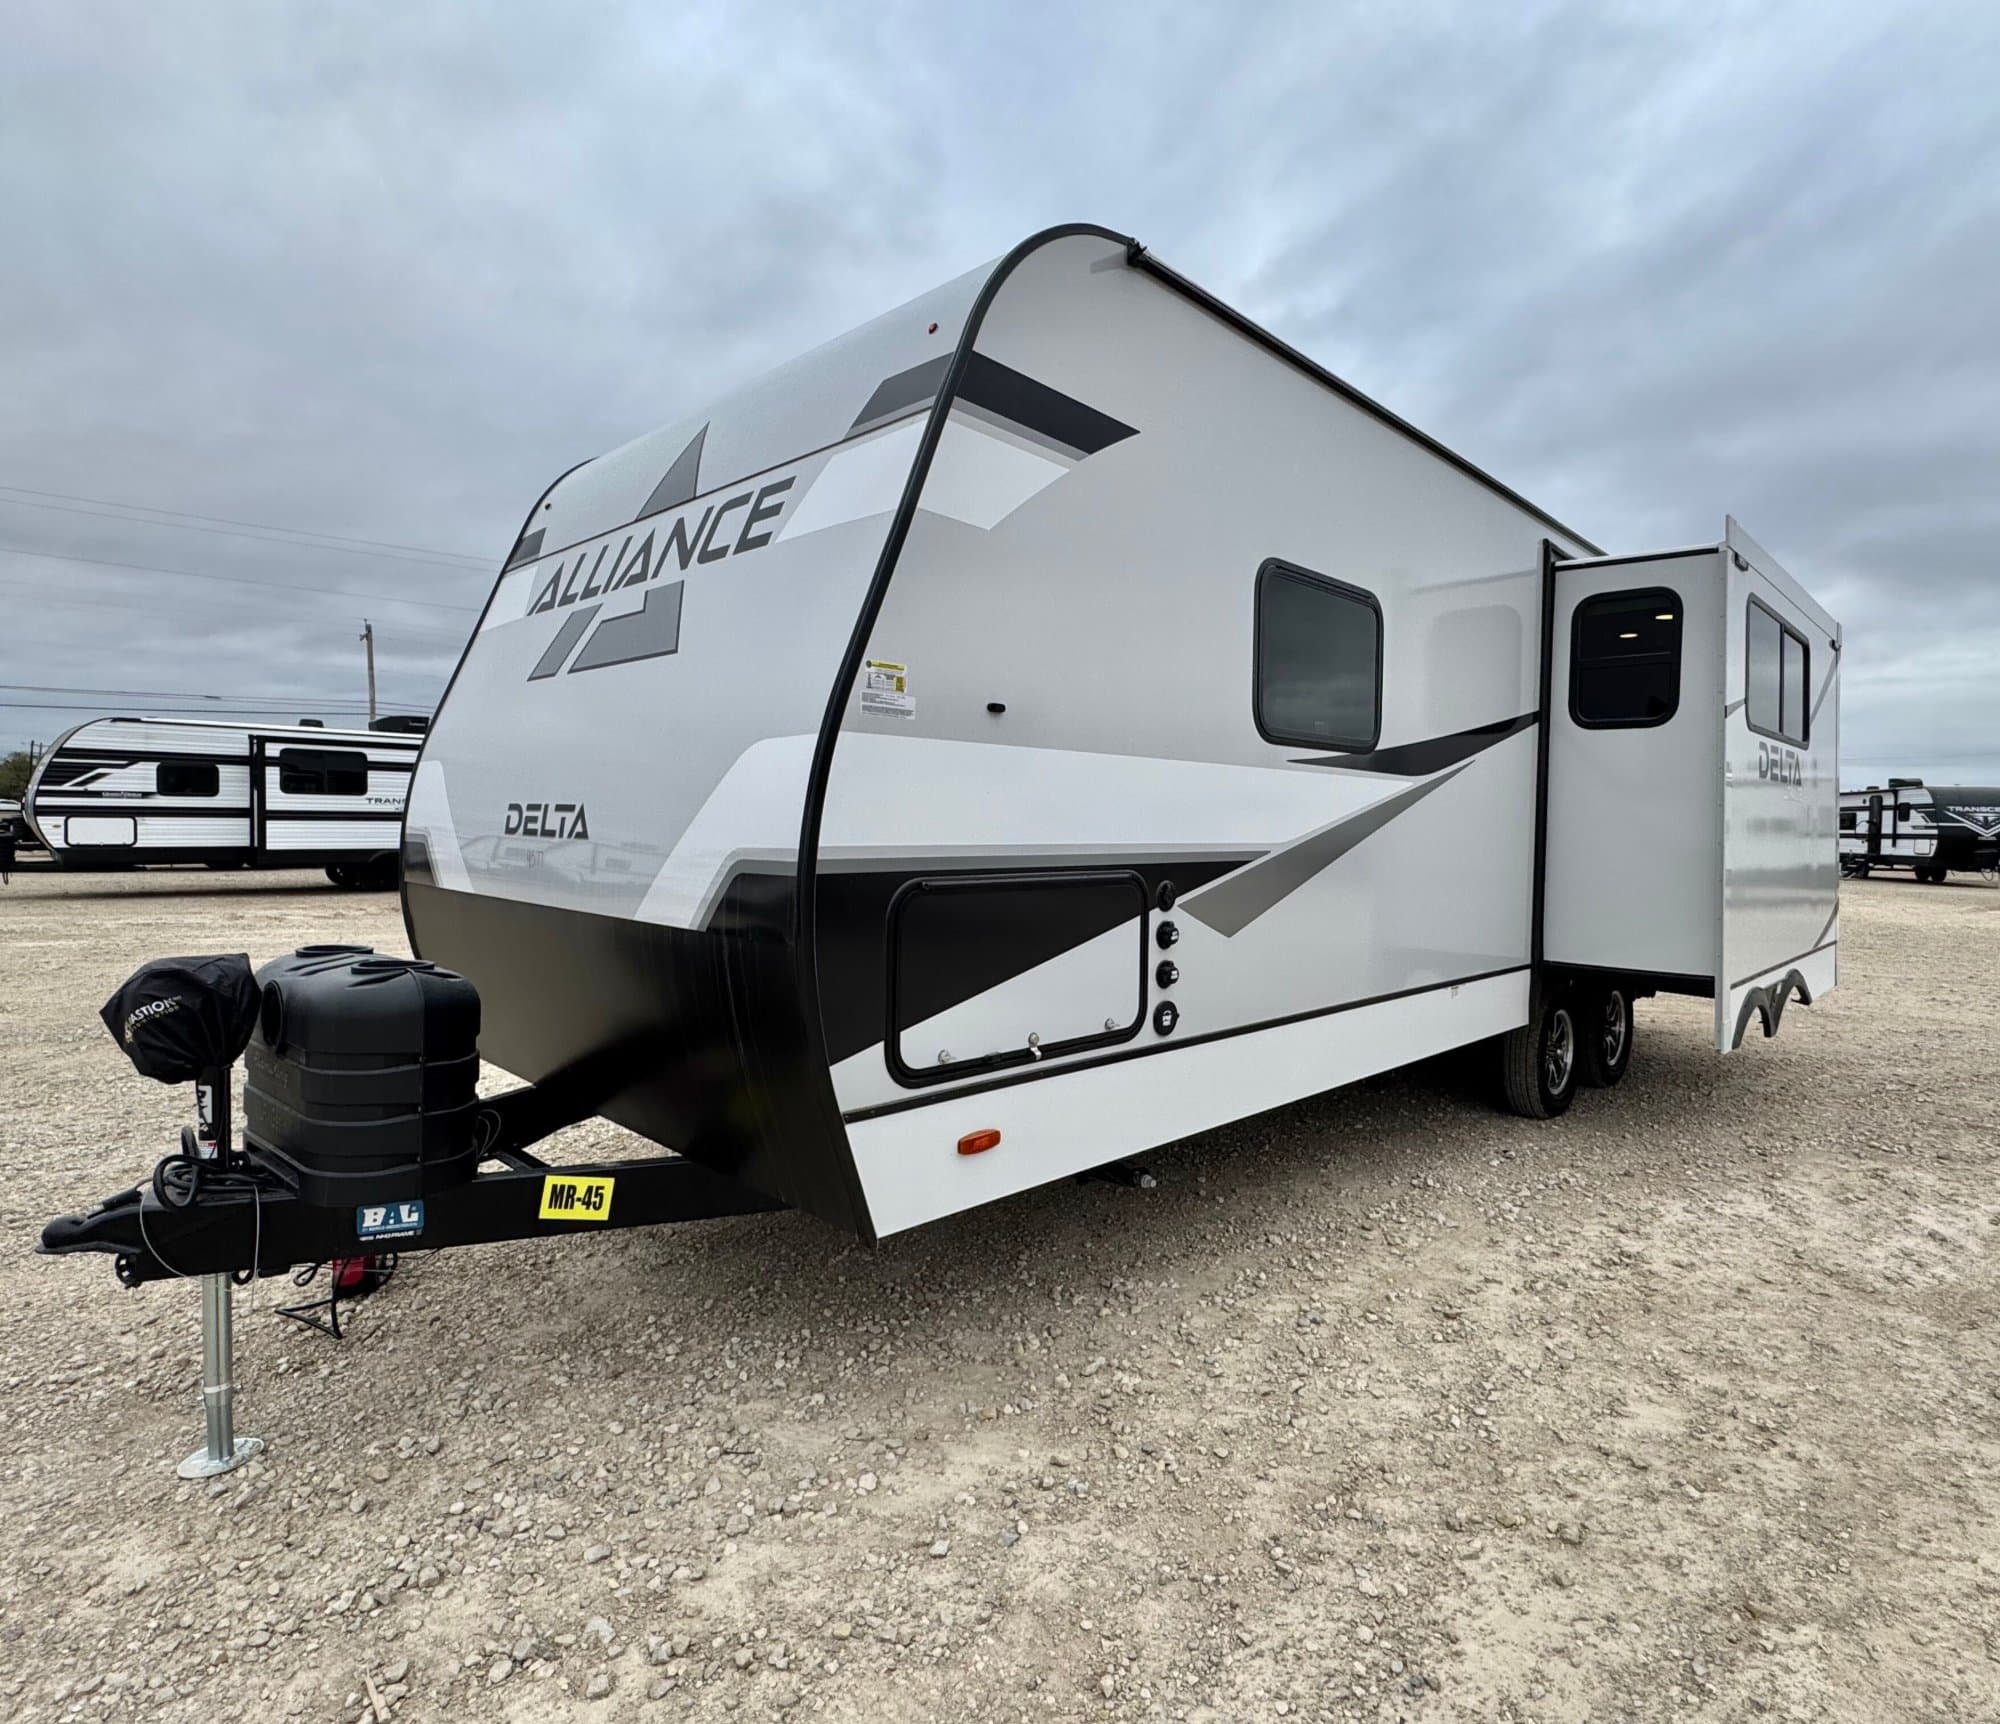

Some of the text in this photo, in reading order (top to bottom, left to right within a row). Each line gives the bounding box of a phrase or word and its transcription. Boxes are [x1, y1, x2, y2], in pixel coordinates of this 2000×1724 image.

[526, 475, 797, 617] ALLIANCE
[1758, 741, 1802, 787] DELTA
[504, 802, 589, 840] DELTA
[548, 1183, 605, 1211] MR-45
